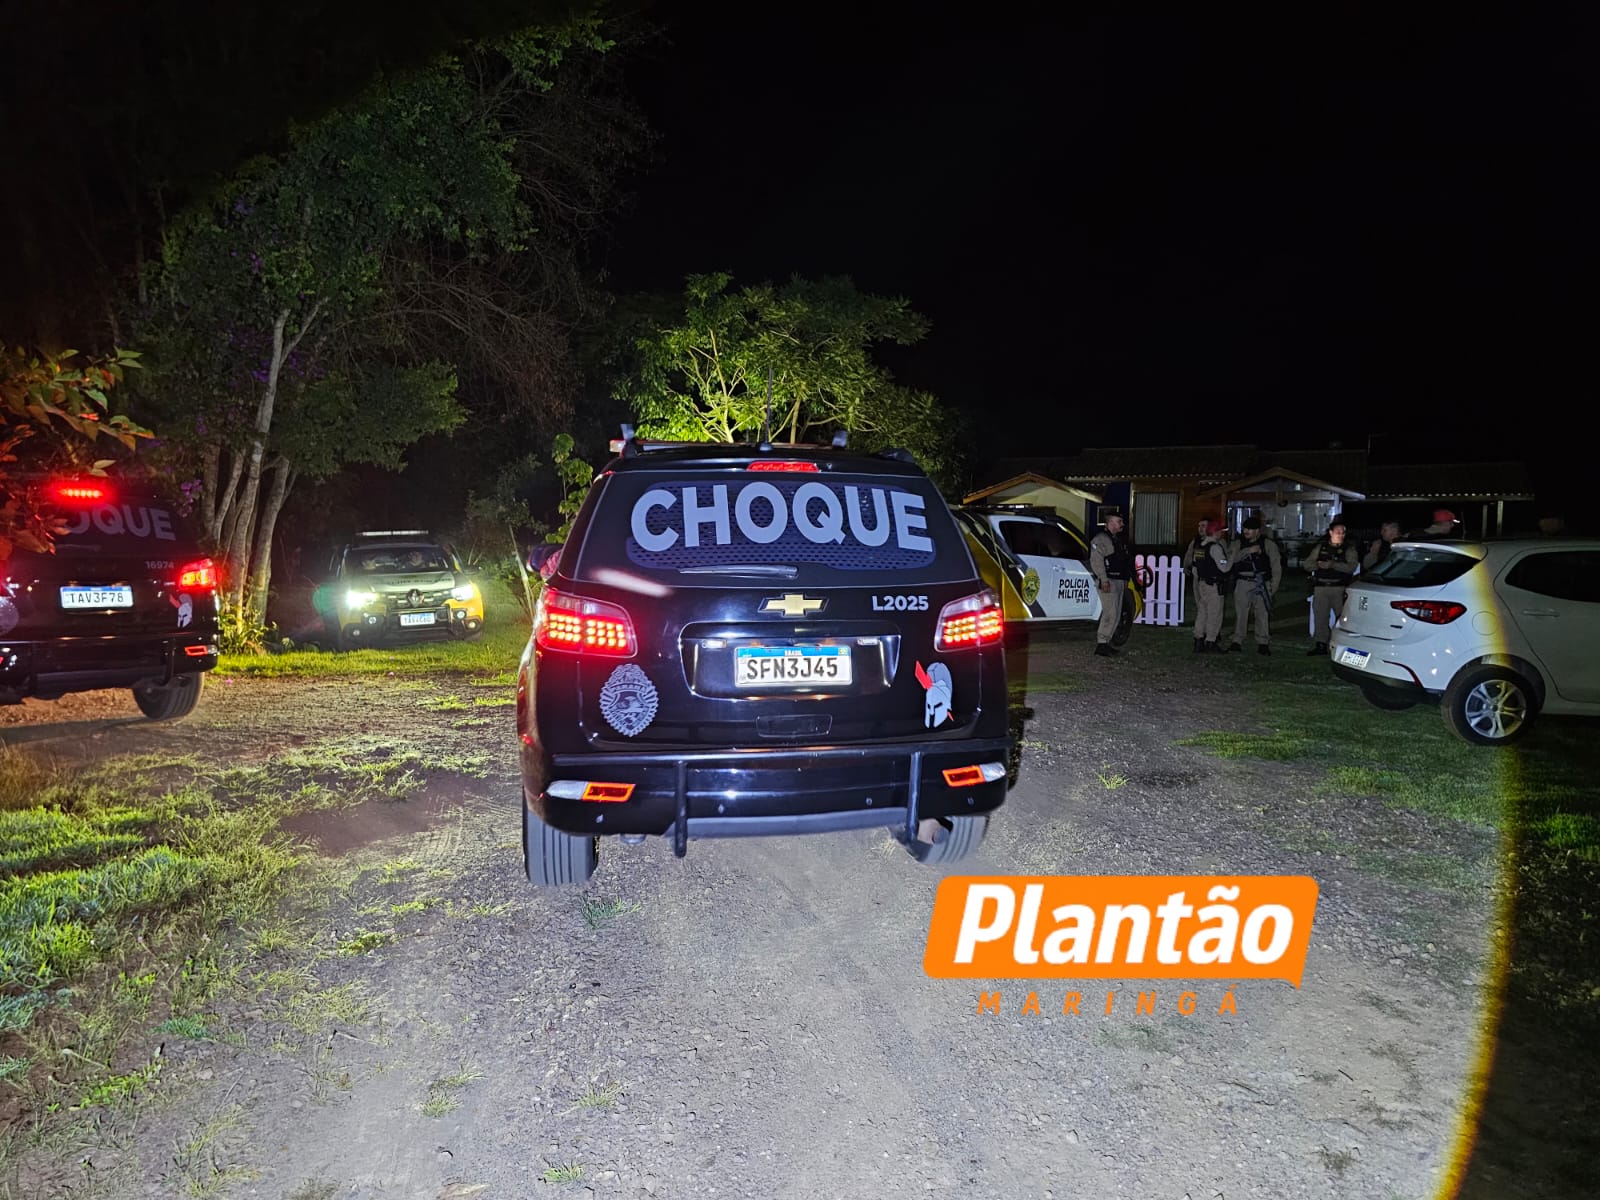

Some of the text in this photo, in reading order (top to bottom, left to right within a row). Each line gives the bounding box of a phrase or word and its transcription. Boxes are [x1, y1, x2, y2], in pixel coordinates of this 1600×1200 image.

[630, 481, 933, 553] CHOQUE
[1058, 577, 1090, 589] POLÍCIA
[871, 594, 930, 612] L2025
[1057, 588, 1090, 600] MILITAR
[746, 656, 839, 680] SFN3J45
